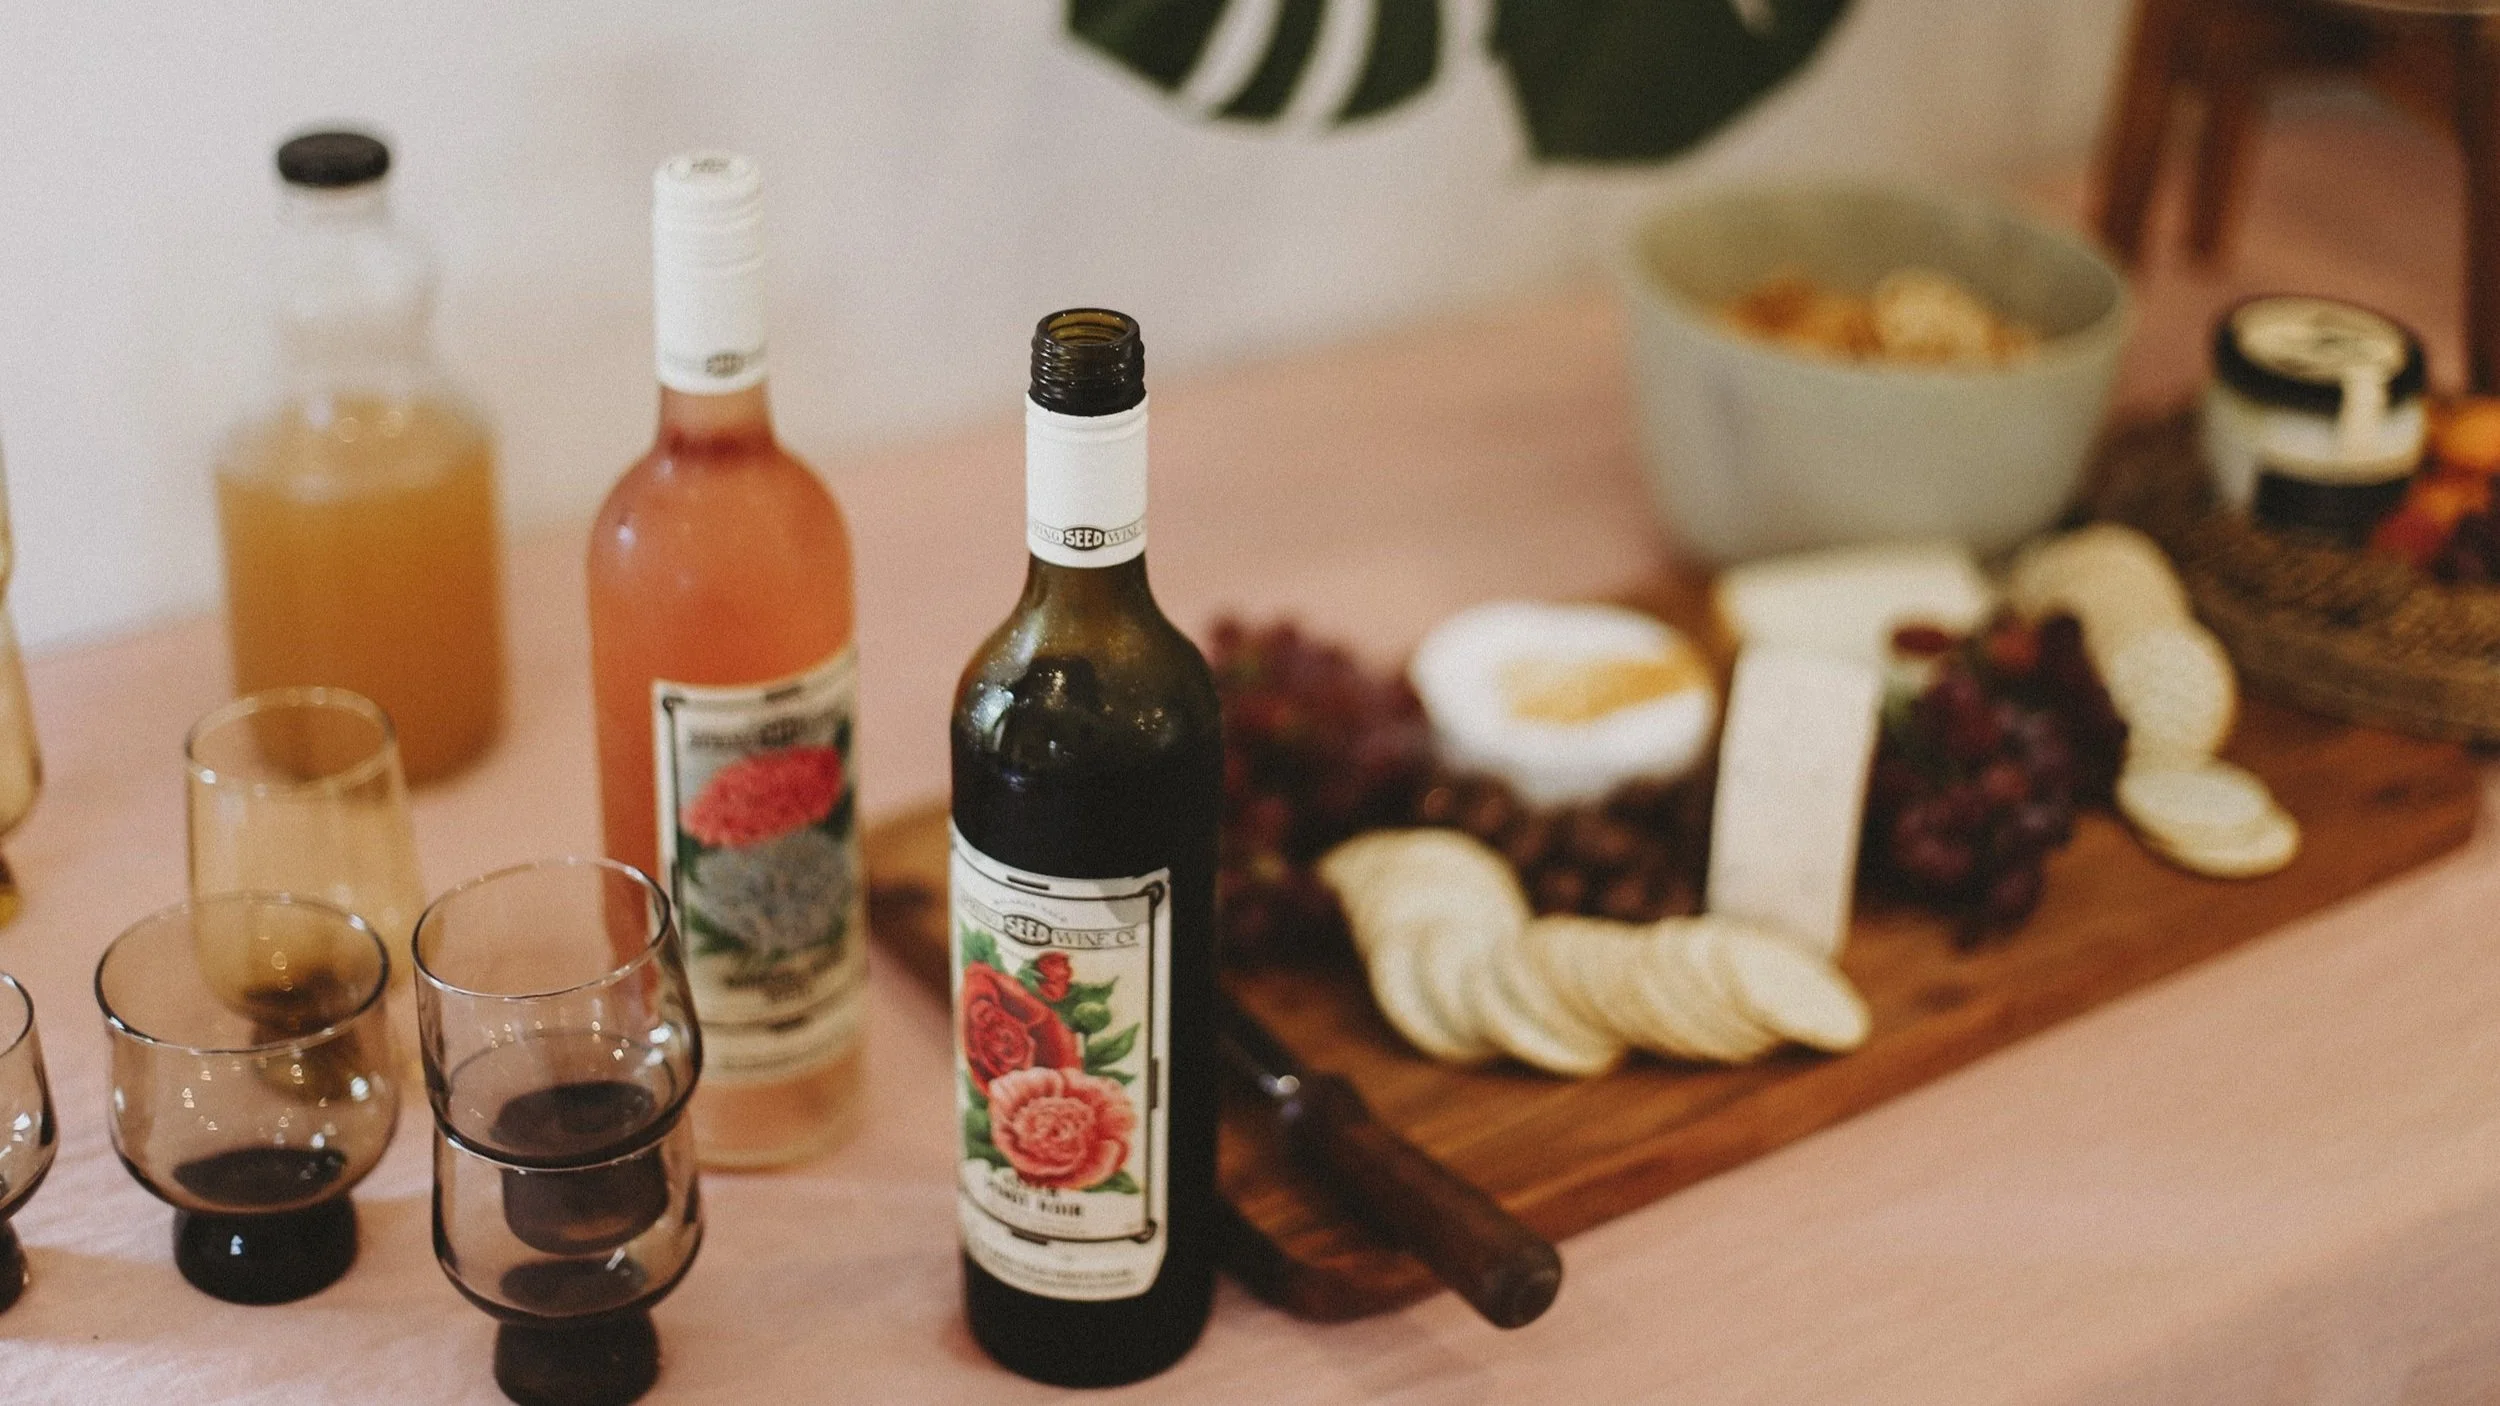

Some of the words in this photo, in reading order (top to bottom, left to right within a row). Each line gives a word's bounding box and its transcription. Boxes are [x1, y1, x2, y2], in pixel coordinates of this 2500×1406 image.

[1064, 530, 1101, 547] SEED
[1005, 916, 1048, 942] SEED
[1056, 931, 1108, 946] WINE
